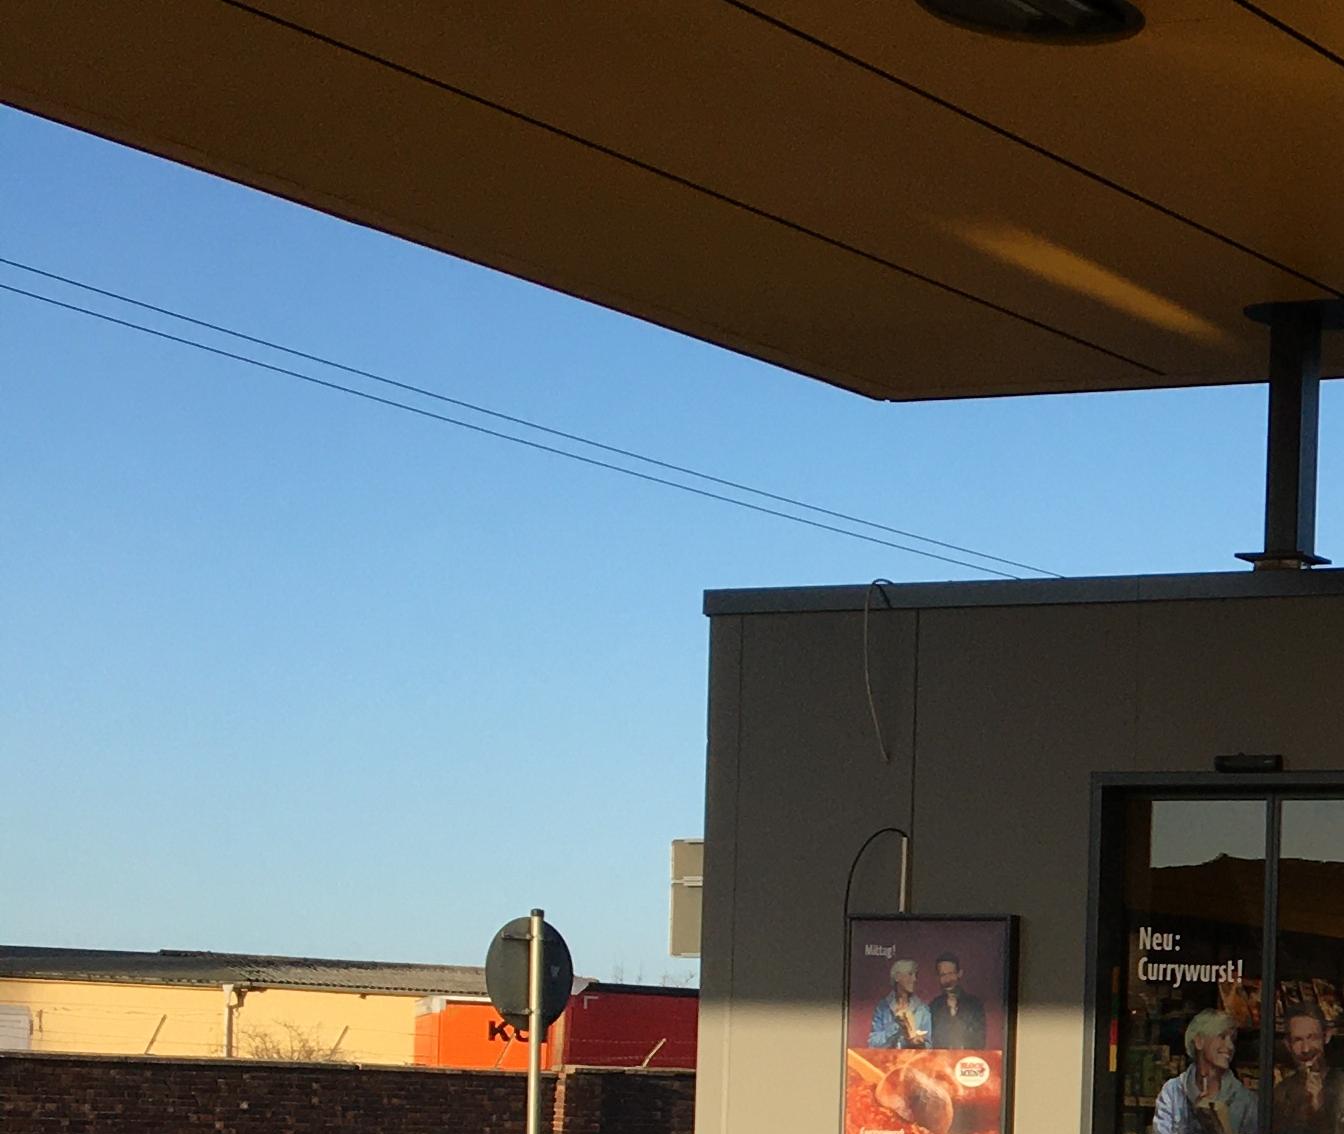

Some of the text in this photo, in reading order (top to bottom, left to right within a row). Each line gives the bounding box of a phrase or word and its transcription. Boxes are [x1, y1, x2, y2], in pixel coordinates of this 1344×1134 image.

[864, 944, 896, 960] Mittag!
[1138, 926, 1181, 952] Neu:
[1137, 956, 1243, 989] Currywurst!
